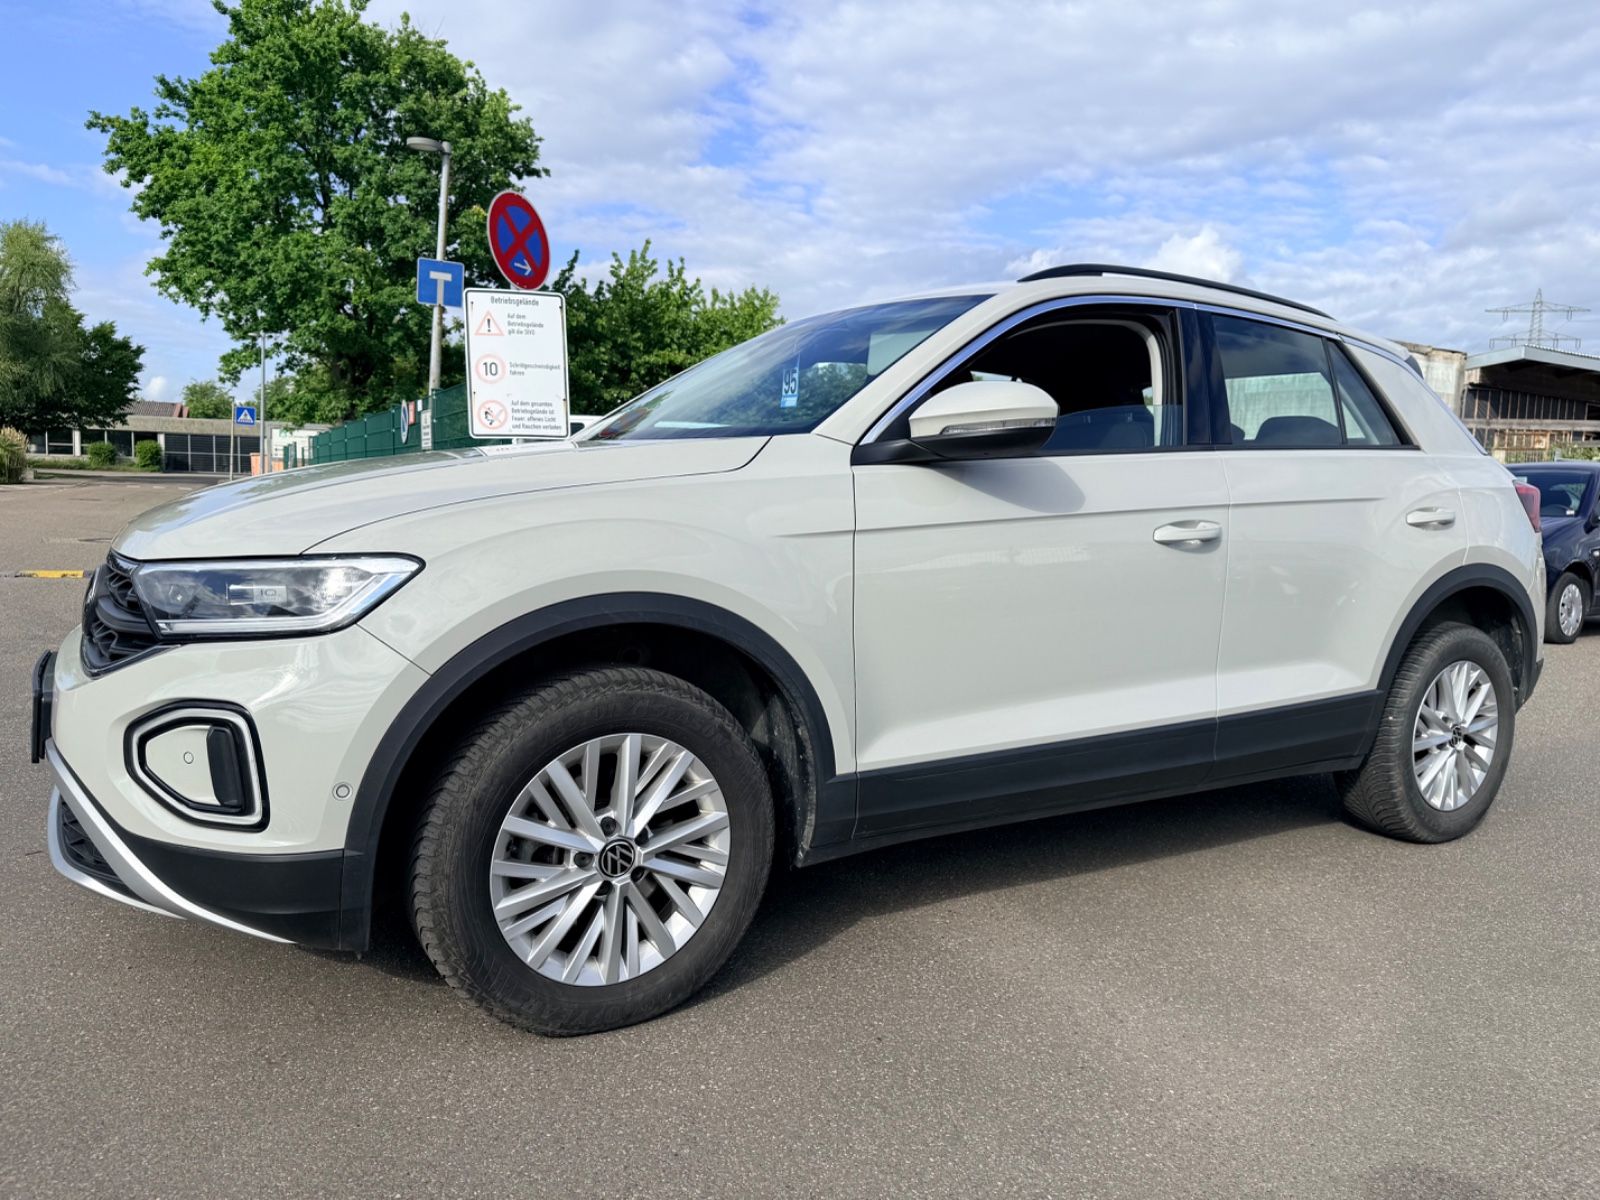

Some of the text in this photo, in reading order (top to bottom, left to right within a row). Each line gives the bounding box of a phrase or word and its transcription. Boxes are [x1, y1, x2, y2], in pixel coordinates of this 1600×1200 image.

[490, 295, 539, 307] Betriebsgelände
[482, 361, 498, 377] 10
[783, 369, 797, 394] 95
